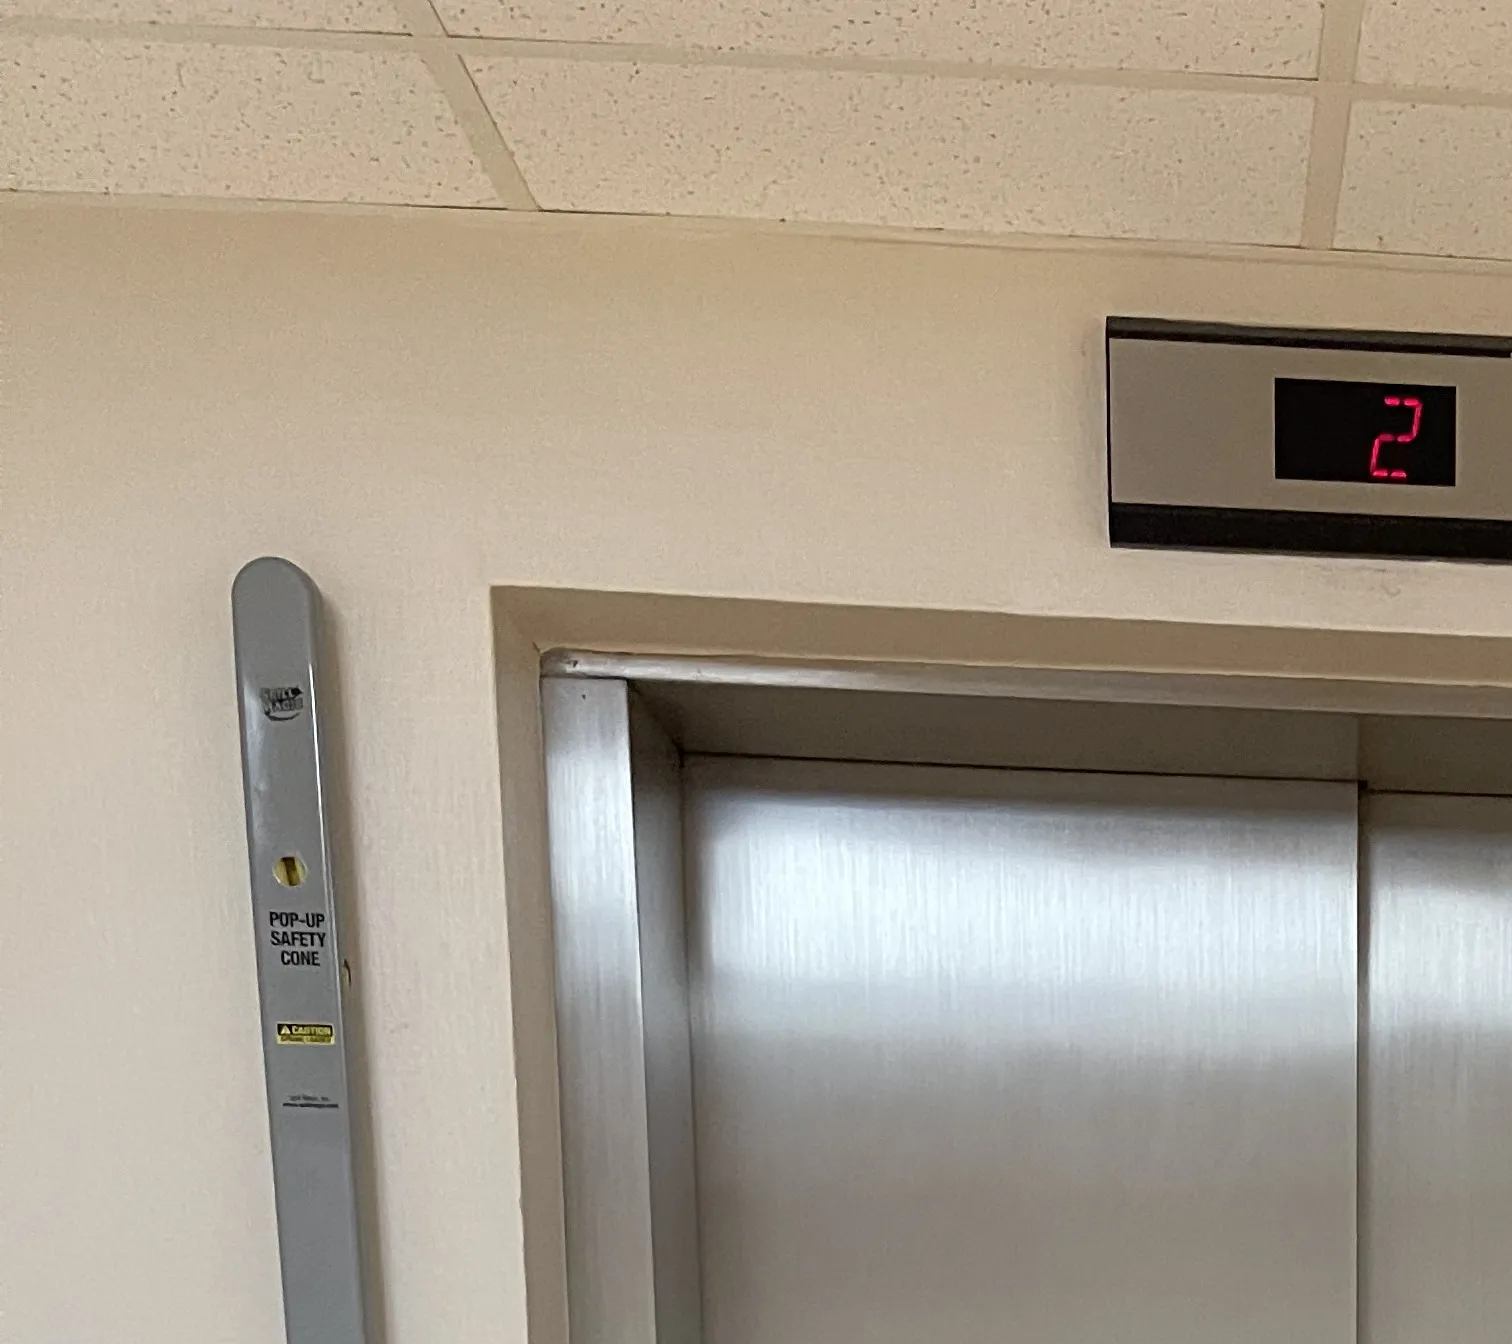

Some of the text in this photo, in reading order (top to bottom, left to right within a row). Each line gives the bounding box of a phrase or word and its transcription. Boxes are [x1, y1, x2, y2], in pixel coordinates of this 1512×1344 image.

[1369, 395, 1422, 478] 2
[269, 911, 325, 928] POP-UP
[270, 931, 326, 947] SAFETY
[281, 950, 321, 966] CONE
[291, 1025, 331, 1036] CAUTION
